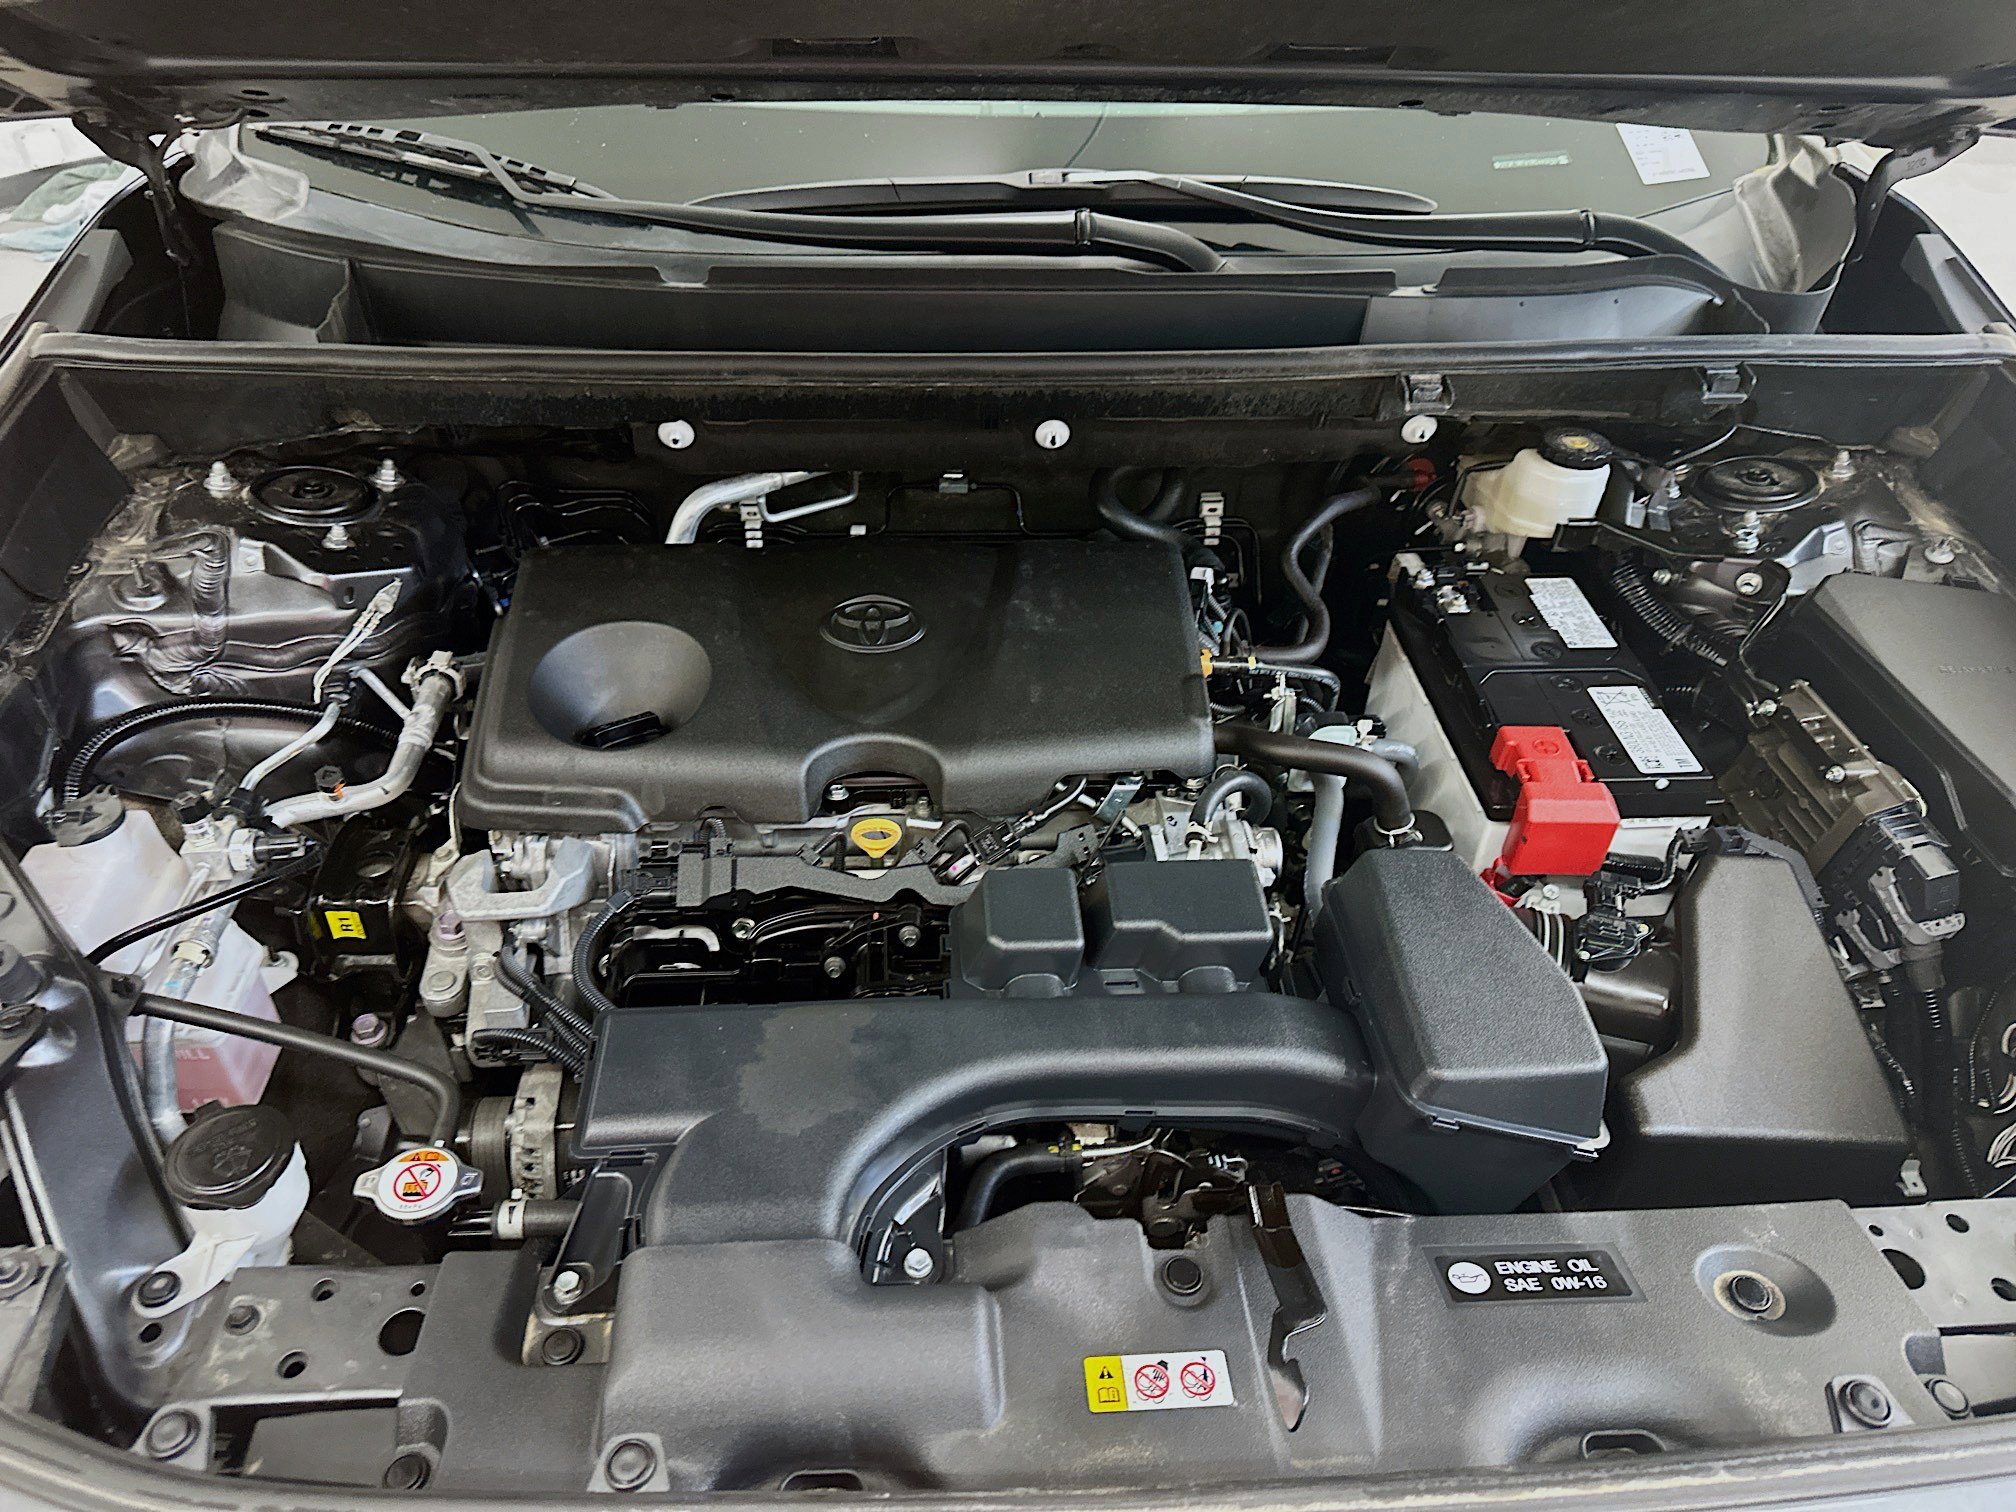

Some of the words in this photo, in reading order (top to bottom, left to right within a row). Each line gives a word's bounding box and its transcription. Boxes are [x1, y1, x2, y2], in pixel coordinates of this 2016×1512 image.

[338, 917, 354, 932] R1
[1494, 1259, 1561, 1275] ENGINE
[1566, 1258, 1600, 1273] OIL
[1504, 1277, 1544, 1292] SAE
[1551, 1275, 1608, 1291] 0W-16
